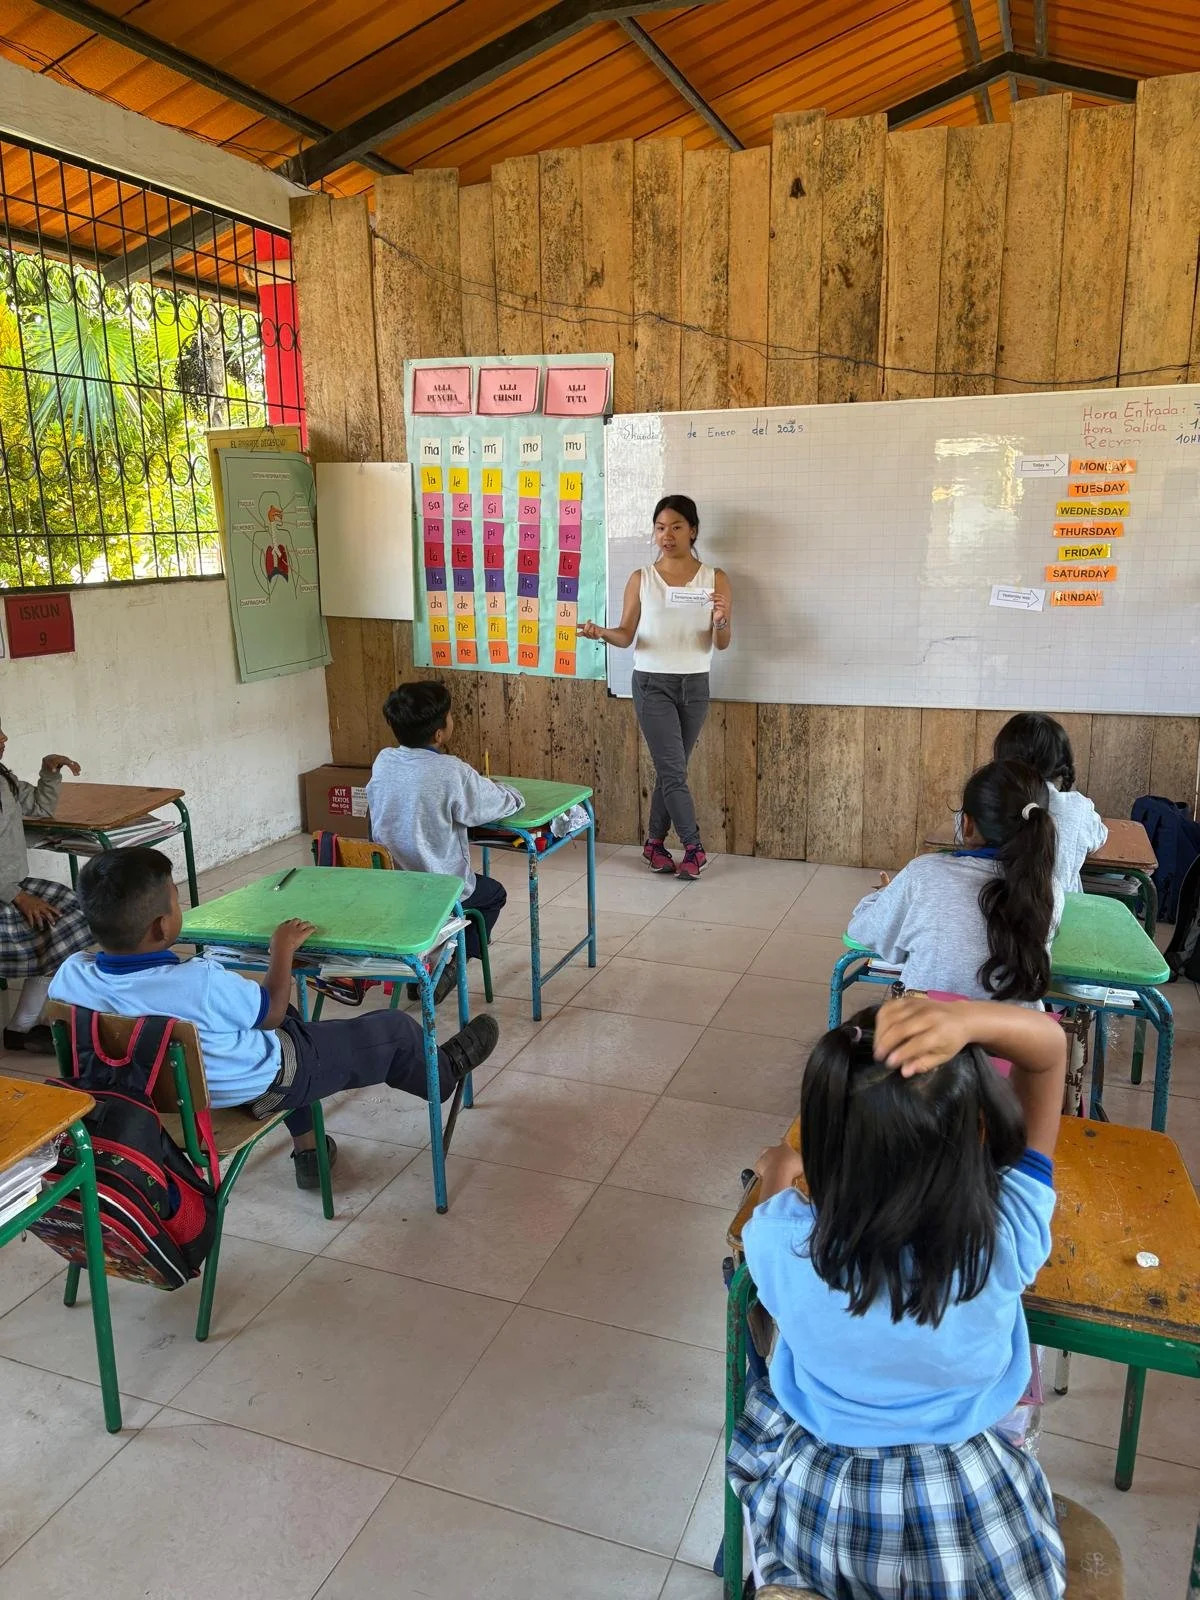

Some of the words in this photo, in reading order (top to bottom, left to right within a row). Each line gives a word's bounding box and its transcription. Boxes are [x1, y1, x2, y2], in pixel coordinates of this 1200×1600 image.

[1083, 406, 1118, 421] Hora
[687, 421, 697, 438] de
[707, 427, 736, 438] Enero
[752, 418, 768, 436] del
[777, 424, 804, 434] 2025
[1083, 422, 1112, 435] Hora
[1124, 418, 1167, 433] Salida
[424, 445, 440, 456] ma
[452, 445, 464, 456] me
[523, 442, 538, 454] mo
[566, 441, 582, 450] mu
[1074, 484, 1126, 494] TUESDAY
[428, 502, 440, 511] sa
[524, 506, 536, 514] so
[564, 507, 576, 515] su
[1060, 507, 1124, 516] WEDNESDAY
[1060, 528, 1118, 536] THURSDAY
[1064, 548, 1104, 557] FRIDAY
[1052, 569, 1110, 578] SATURDAY
[20, 604, 60, 620] ISKUN
[430, 596, 442, 609] da
[456, 596, 468, 610] de
[490, 596, 498, 608] di
[522, 600, 532, 613] do
[560, 604, 570, 618] du
[40, 632, 48, 646] 9
[334, 788, 346, 796] KIT
